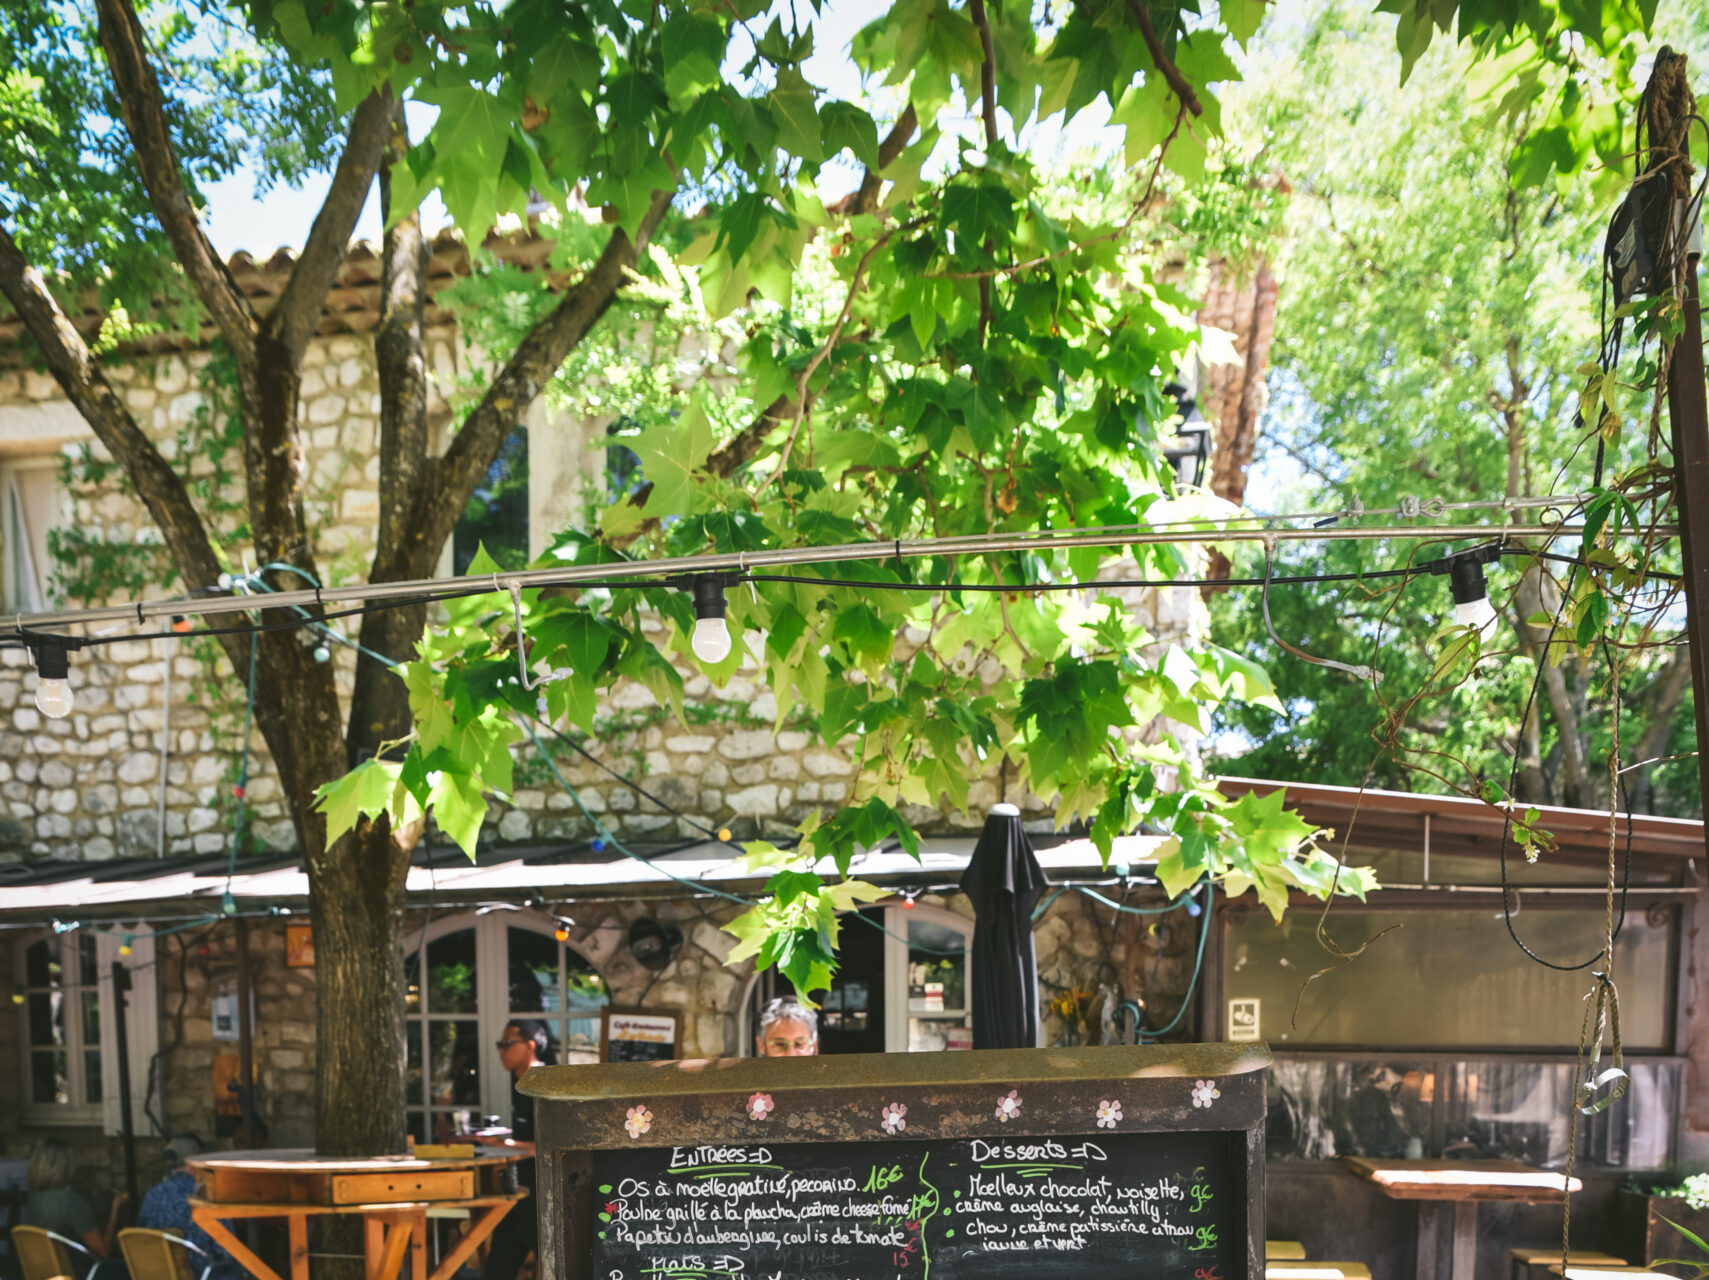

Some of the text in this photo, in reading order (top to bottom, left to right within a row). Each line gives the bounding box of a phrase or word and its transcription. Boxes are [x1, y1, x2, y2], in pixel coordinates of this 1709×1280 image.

[970, 1139, 1068, 1163] Desserts
[618, 1178, 650, 1197] Os
[655, 1180, 670, 1197] à
[666, 1200, 709, 1230] grillé
[710, 1202, 723, 1220] à
[725, 1200, 743, 1220] la
[783, 1220, 828, 1246] coulis
[831, 1226, 851, 1245] de
[850, 1223, 909, 1248] tomate
